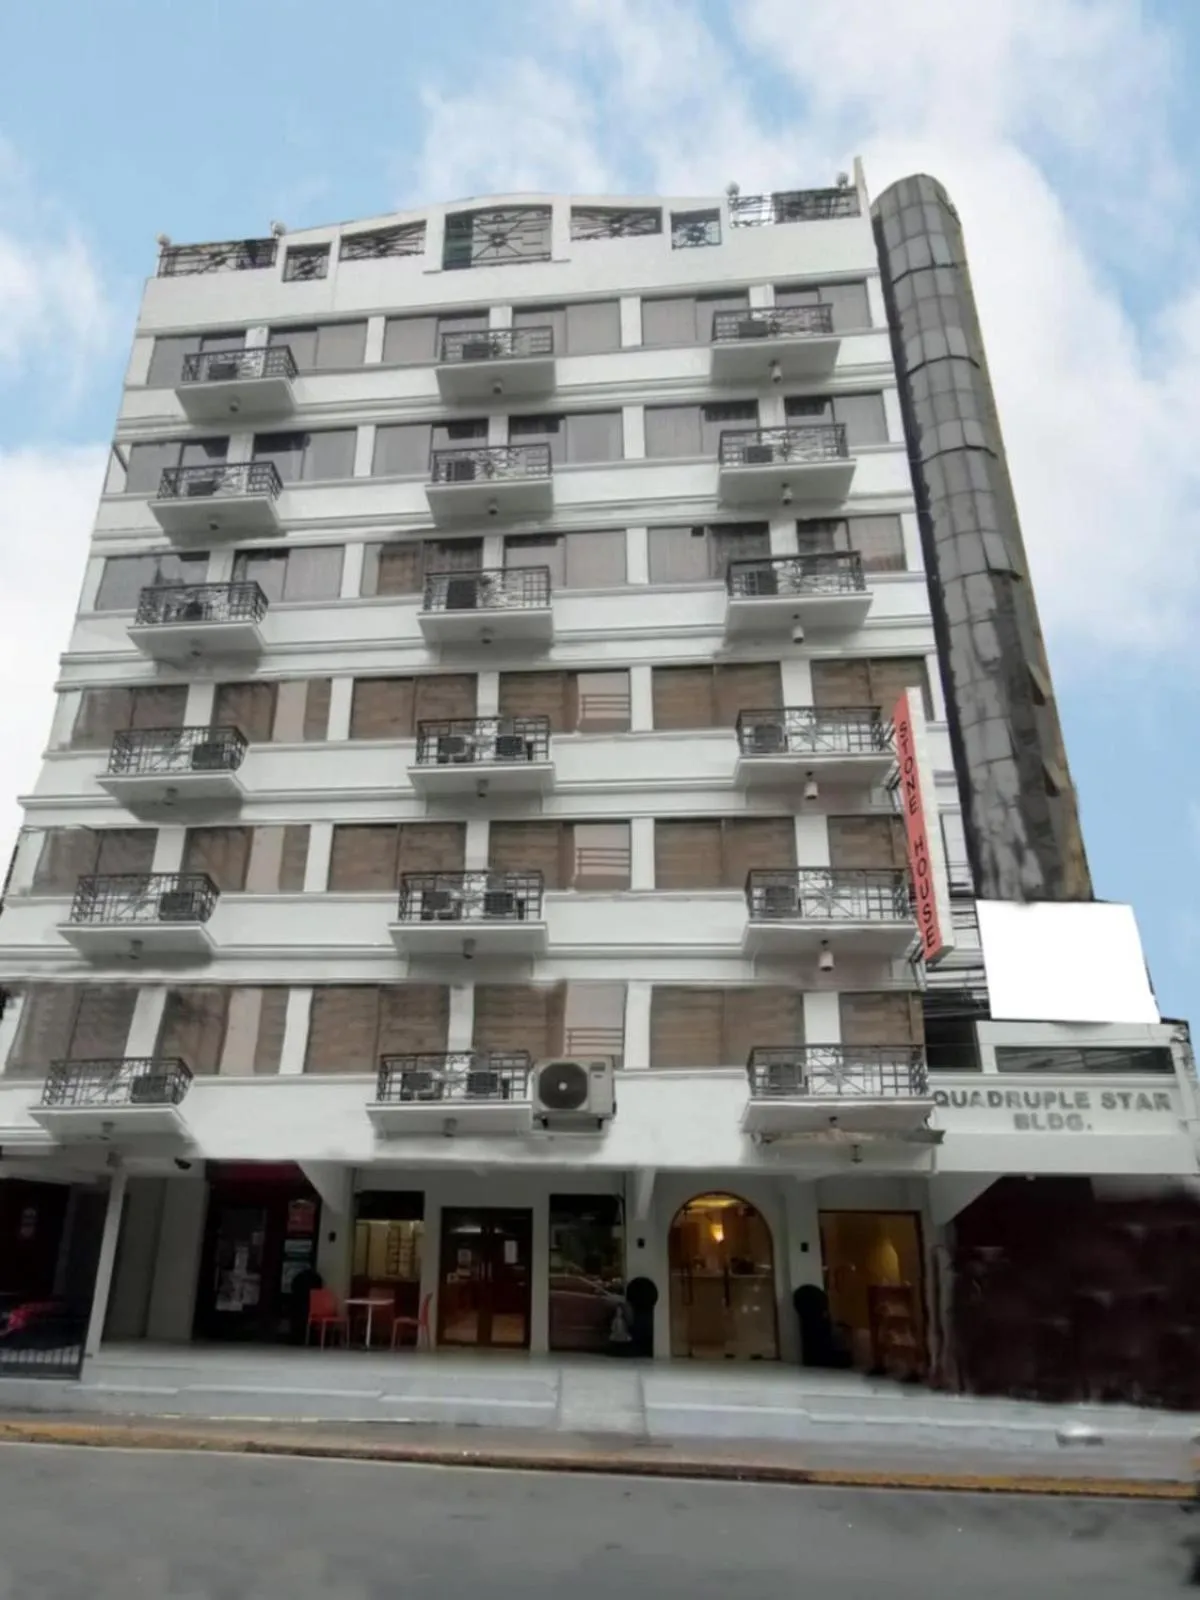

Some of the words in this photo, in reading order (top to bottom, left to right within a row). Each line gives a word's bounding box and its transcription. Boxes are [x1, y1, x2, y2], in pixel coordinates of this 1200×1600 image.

[898, 720, 918, 816] STONE
[914, 836, 937, 948] HOUSE
[933, 1090, 1090, 1110] QUADRUPLE
[1101, 1091, 1172, 1111] STAR
[1013, 1113, 1092, 1131] BLDG.
